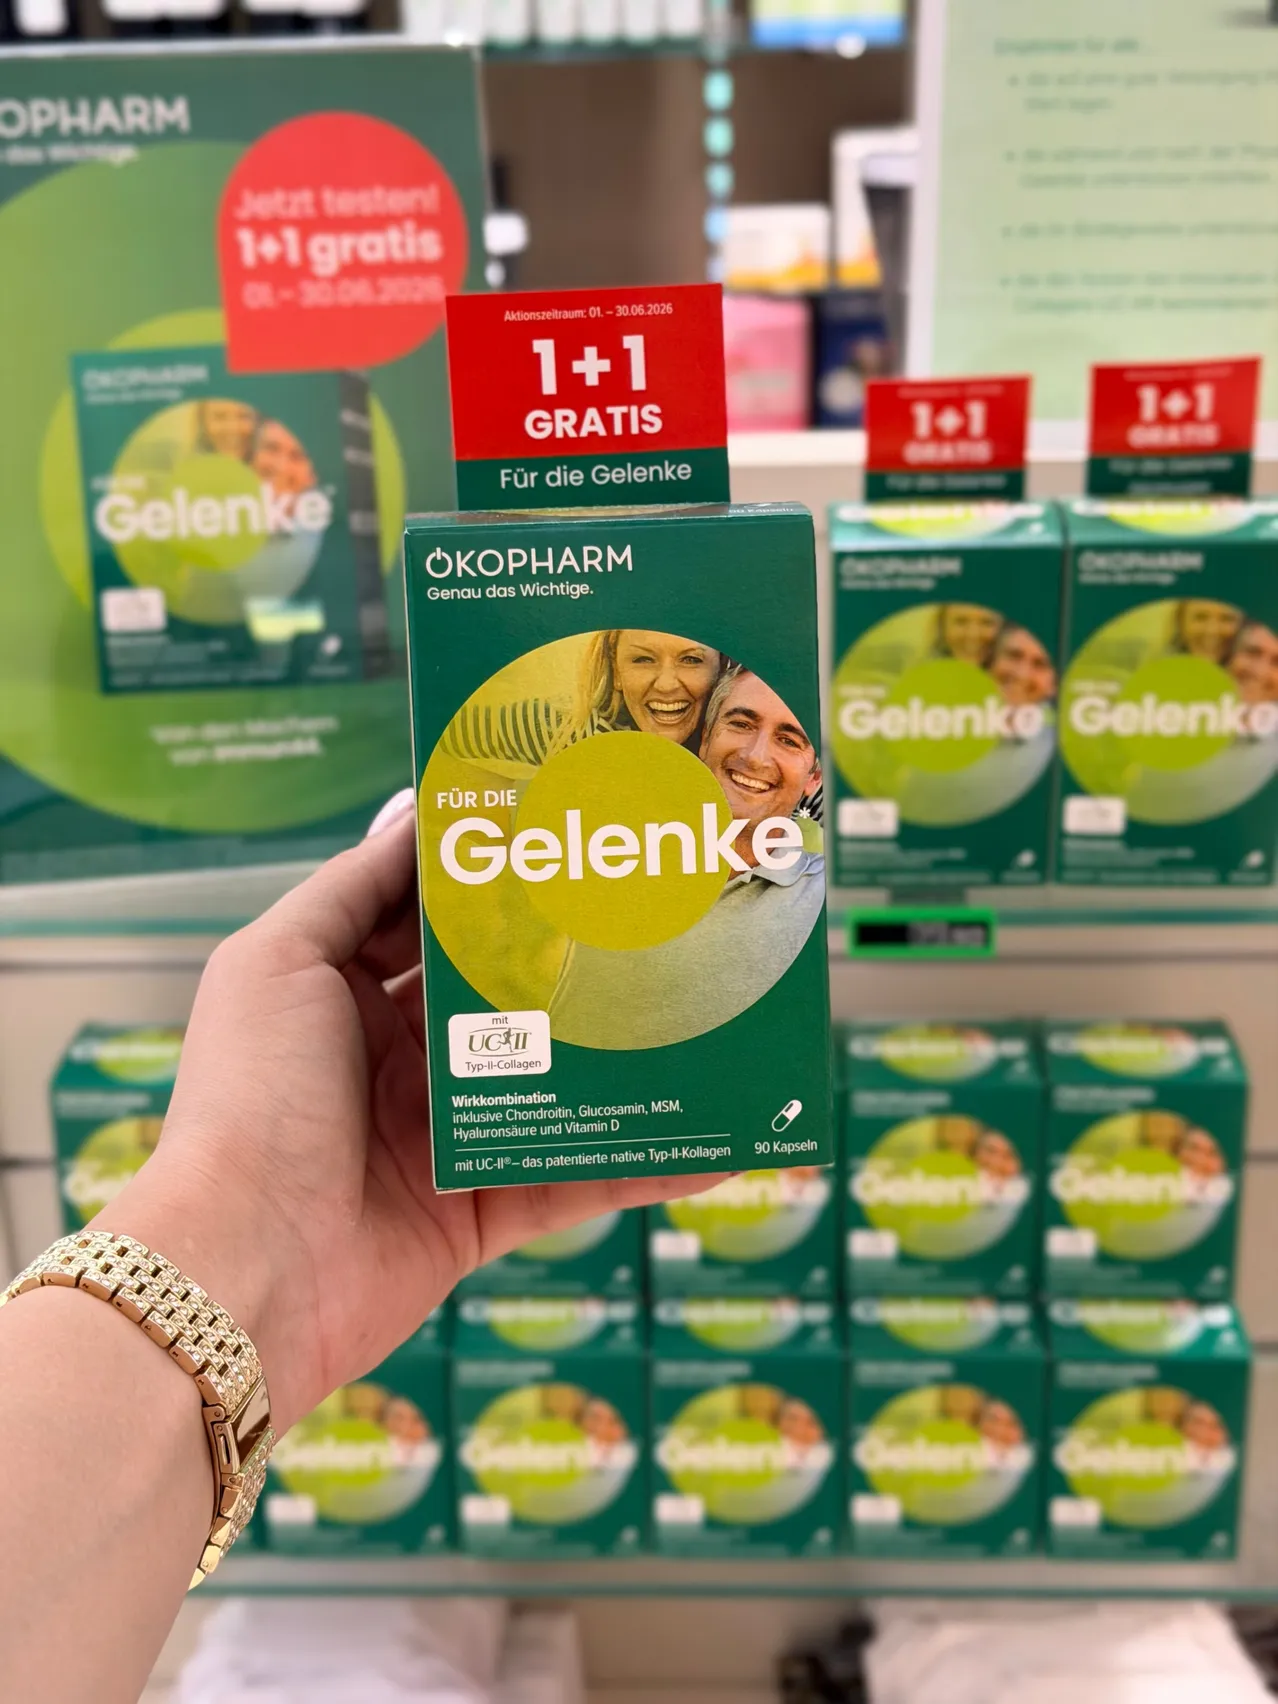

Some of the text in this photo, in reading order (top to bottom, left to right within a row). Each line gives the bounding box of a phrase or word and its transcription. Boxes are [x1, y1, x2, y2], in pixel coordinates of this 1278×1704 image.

[236, 220, 444, 277] 1+1 gratis
[504, 308, 587, 322] Aktionszeitraum:
[588, 306, 604, 318] 01.
[615, 303, 673, 317] 30.06.2026
[524, 404, 663, 440] GRATIS
[500, 460, 692, 489] Für die Gelenke
[427, 581, 594, 600] Genau das Wichtige.
[436, 788, 517, 809] FÜR DIE
[491, 1016, 509, 1025] mit
[465, 1059, 542, 1073] Typ-II-Collagen
[452, 1091, 557, 1108] Wirkkombination
[452, 1099, 684, 1124] inklusive Chondroitin, Glucosamin, MSM,
[453, 1119, 620, 1142] Hyaluronsäure und Vitamin D
[754, 1139, 818, 1155] 90 Kapseln
[455, 1158, 474, 1172] mit
[522, 1154, 543, 1168] das
[545, 1151, 608, 1169] patentierte
[610, 1150, 646, 1164] native
[648, 1145, 731, 1164] Typ-II-Kollagen
